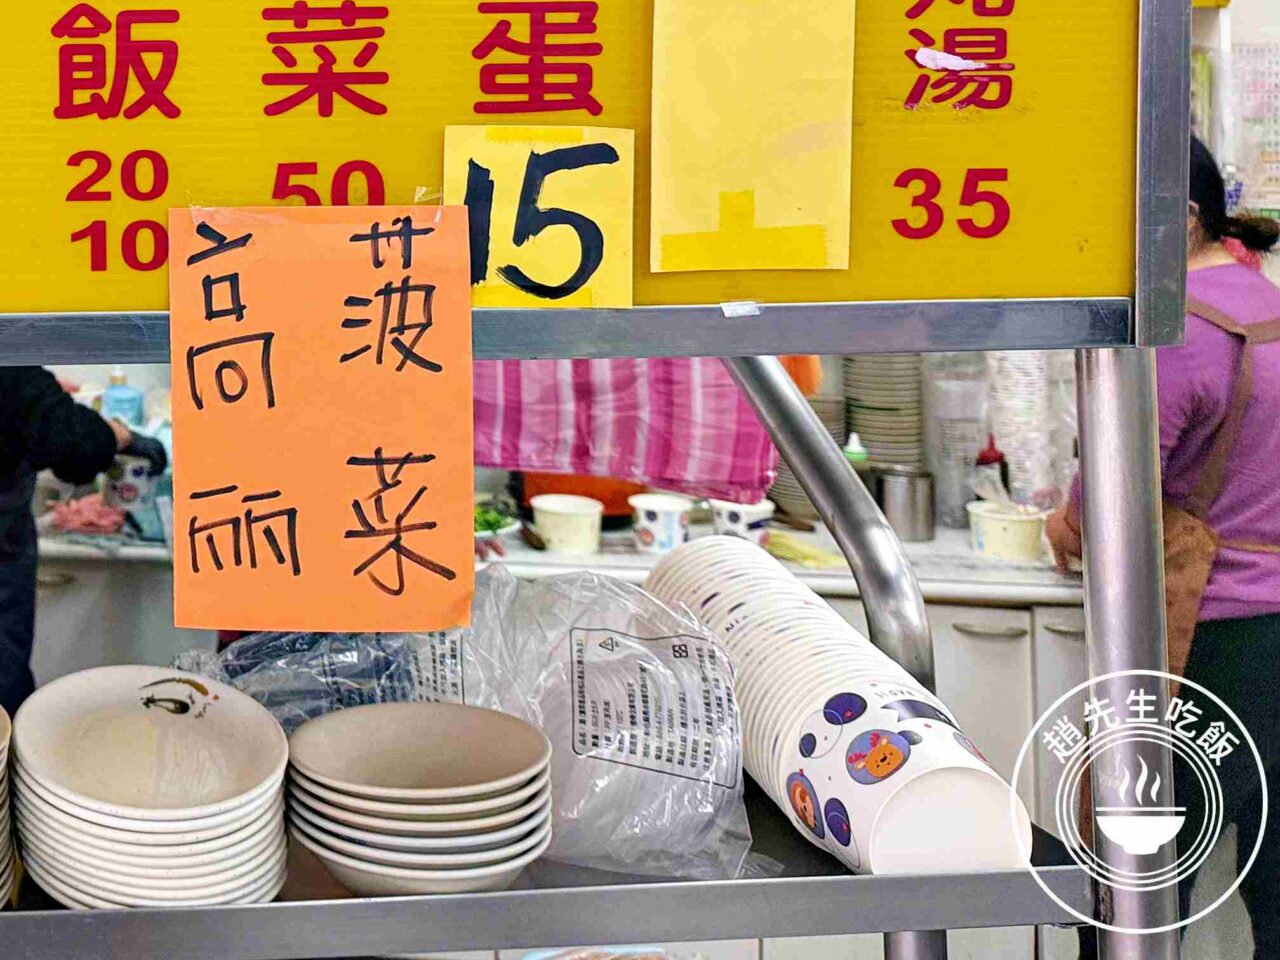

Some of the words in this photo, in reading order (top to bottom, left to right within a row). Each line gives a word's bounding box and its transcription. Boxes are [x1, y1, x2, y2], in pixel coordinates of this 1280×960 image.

[66, 150, 169, 201] 20
[272, 160, 385, 208] 50
[891, 168, 1011, 239] 35
[70, 220, 168, 271] 10
[463, 142, 619, 300] 15
[338, 215, 458, 596] 菠菜
